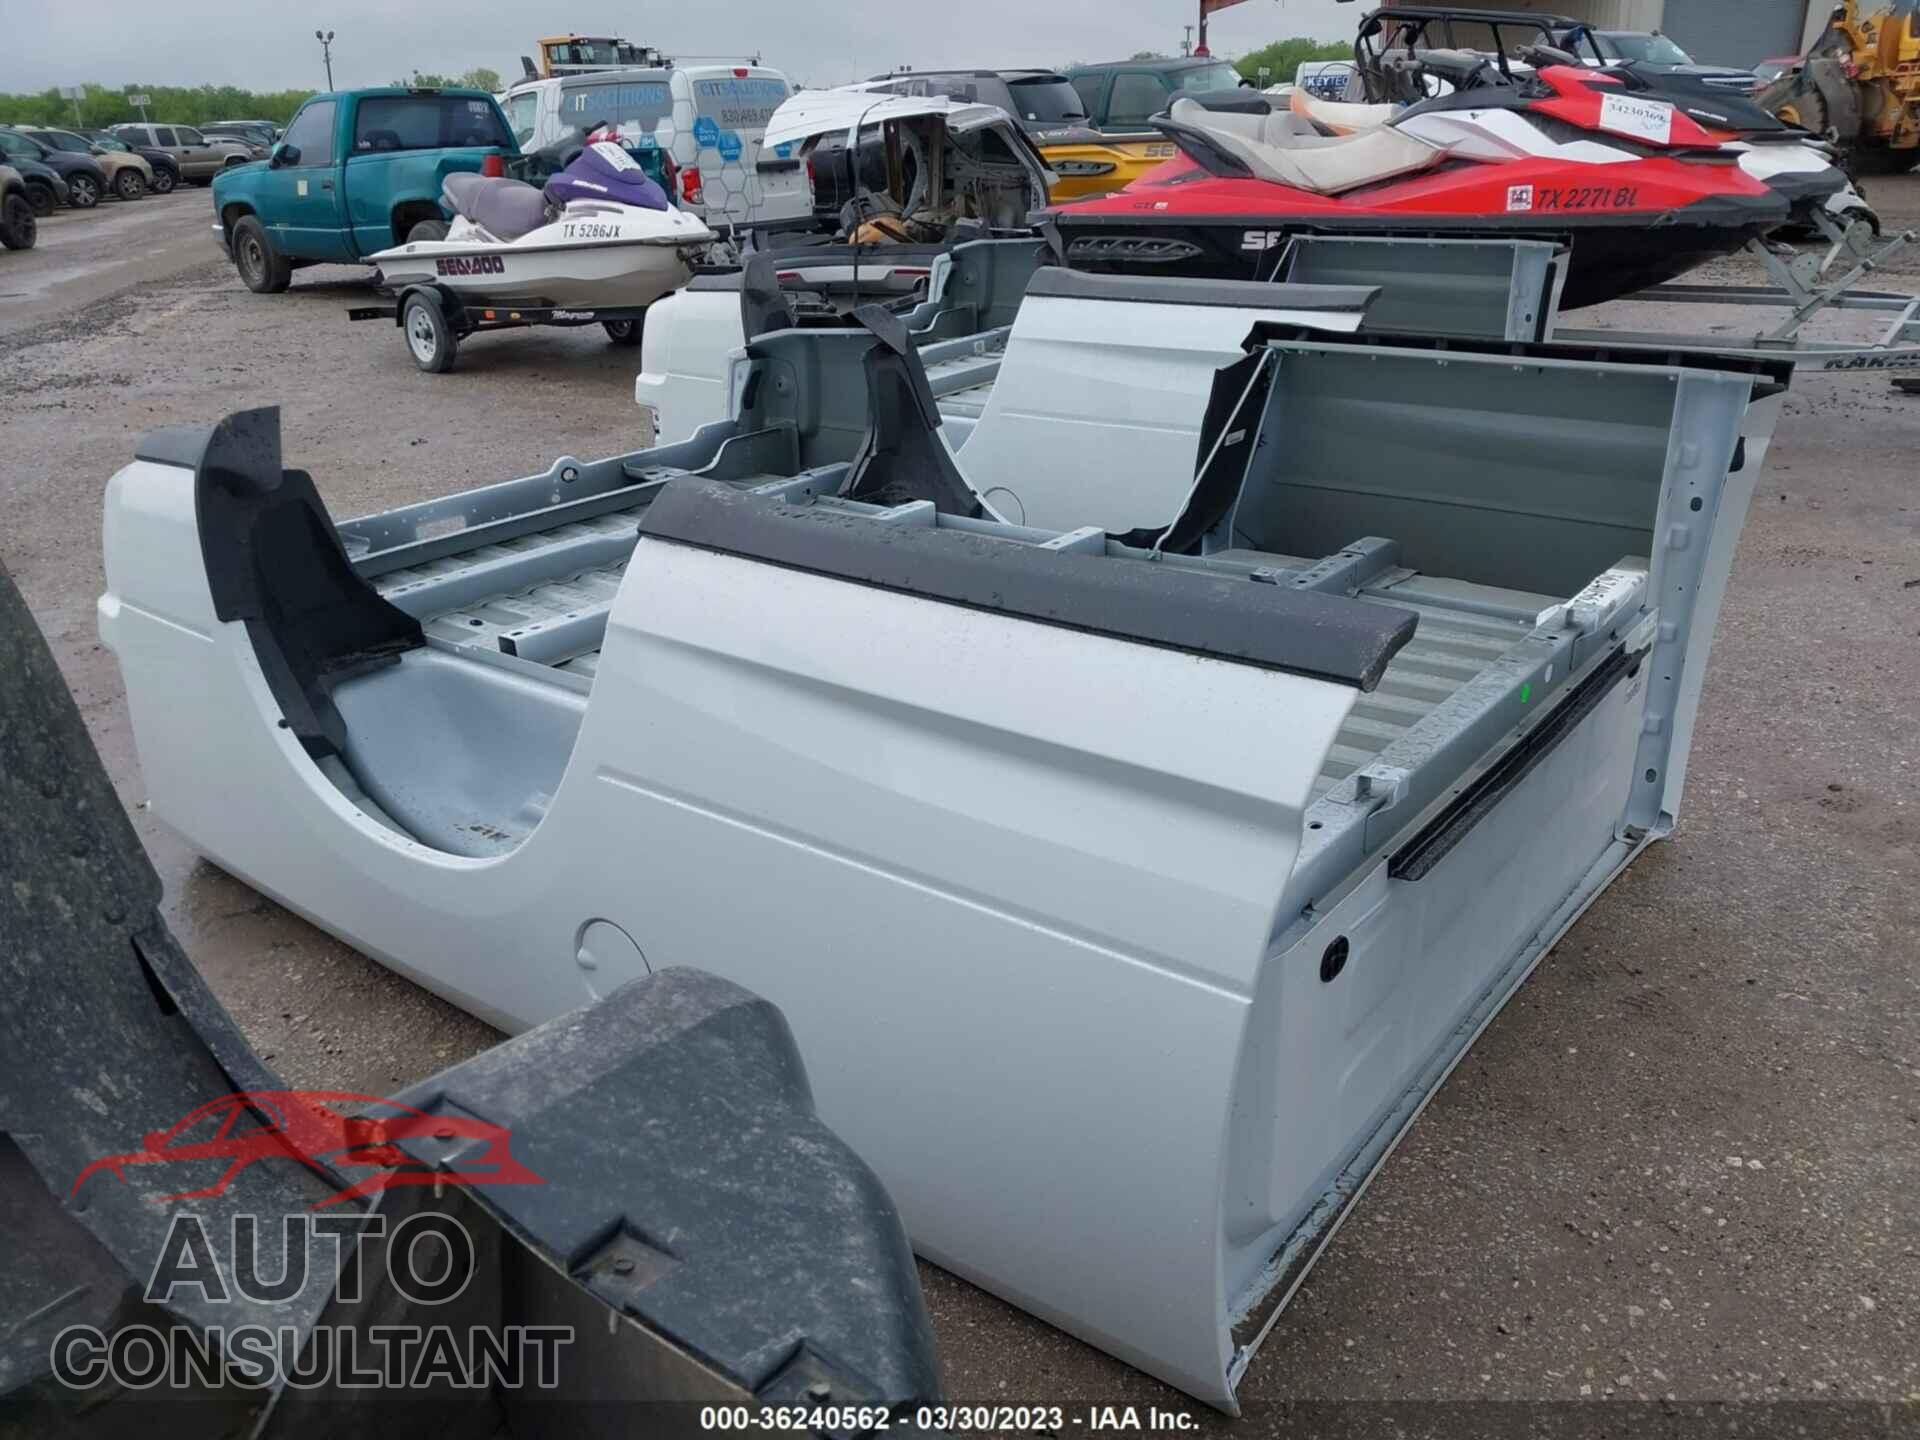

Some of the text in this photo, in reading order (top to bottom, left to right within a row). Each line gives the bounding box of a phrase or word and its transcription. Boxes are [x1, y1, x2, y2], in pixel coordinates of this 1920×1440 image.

[1537, 189, 1562, 208] TX
[1564, 188, 1612, 208] 2271
[563, 223, 622, 238] TX 5286JX
